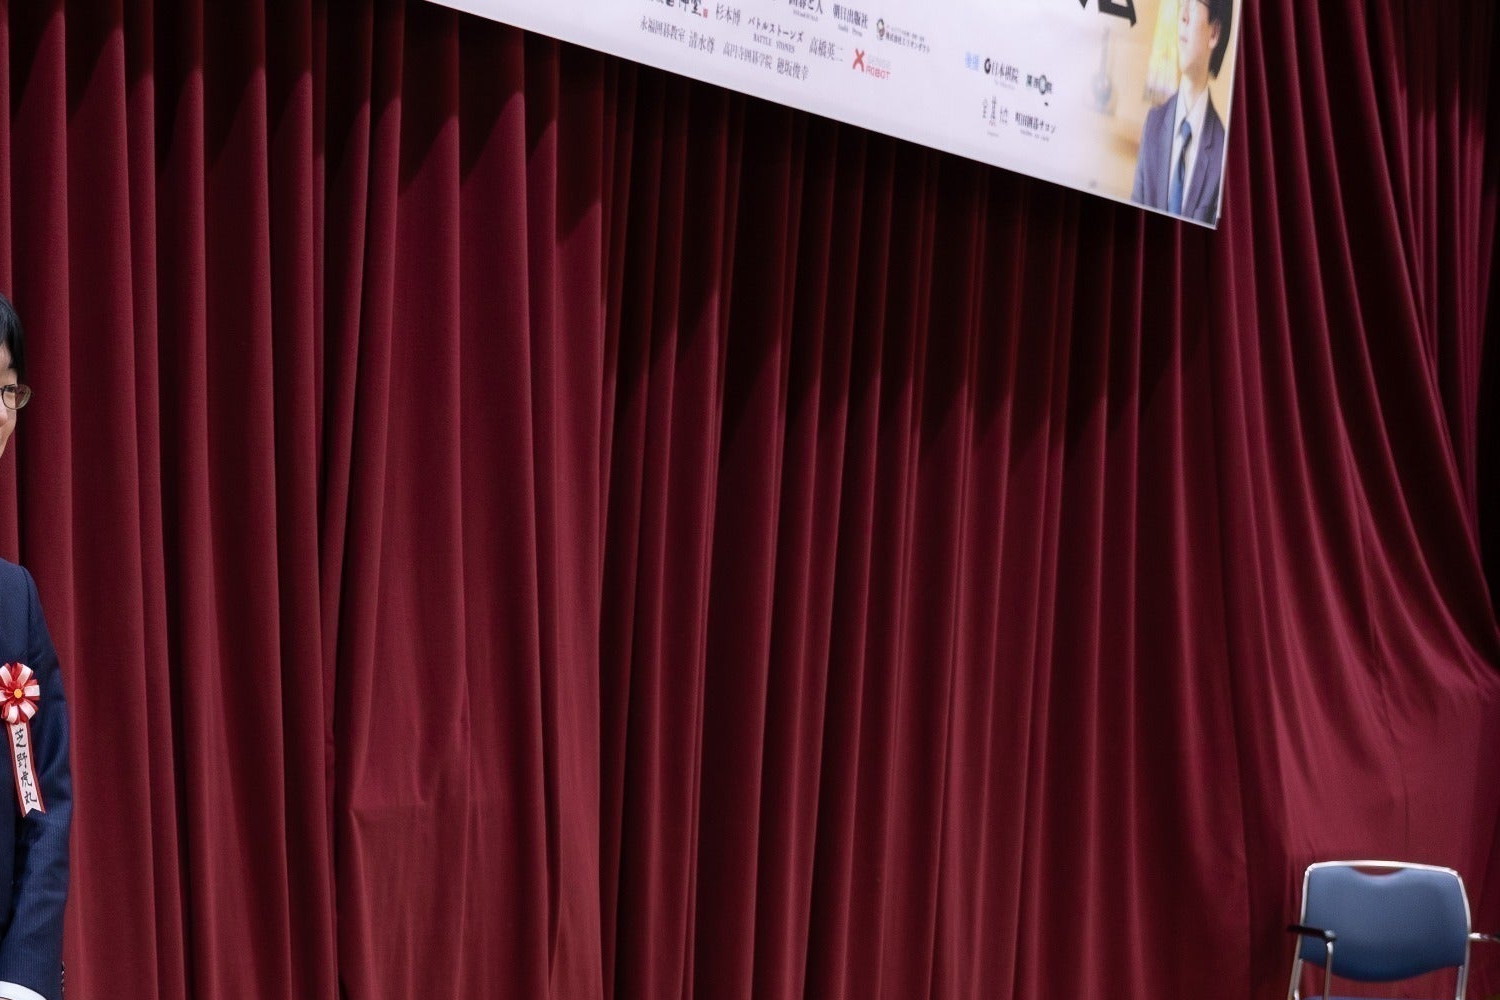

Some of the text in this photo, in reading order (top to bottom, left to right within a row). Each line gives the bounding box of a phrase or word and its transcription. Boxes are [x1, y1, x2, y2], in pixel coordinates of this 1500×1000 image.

[716, 3, 741, 26] 杉本博
[833, 4, 868, 29] 朝日出版社
[641, 16, 686, 43] 永福囲碁教室
[748, 16, 804, 43] バトルストーンズ
[723, 41, 773, 70] 高円寺囲碁学院
[754, 33, 796, 54] BATTLE STONES
[809, 36, 844, 62] 高橋英二
[992, 61, 1019, 83] 日本棋院
